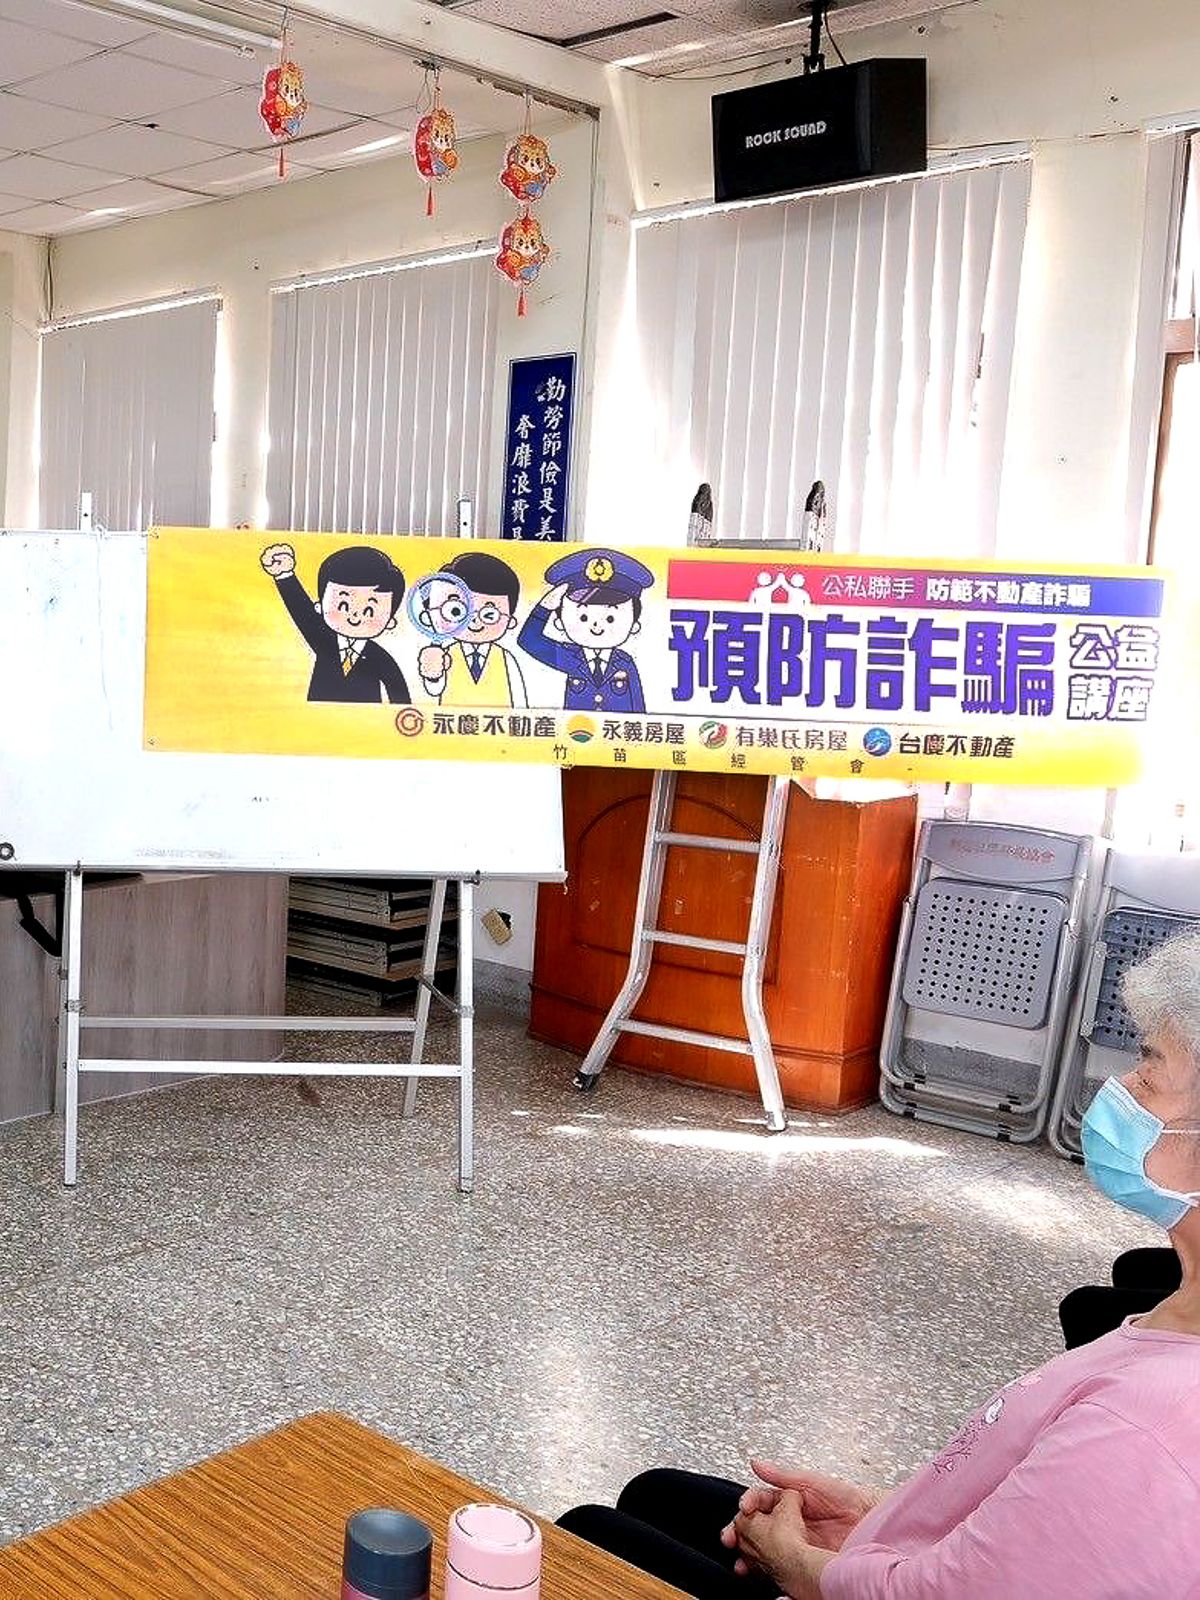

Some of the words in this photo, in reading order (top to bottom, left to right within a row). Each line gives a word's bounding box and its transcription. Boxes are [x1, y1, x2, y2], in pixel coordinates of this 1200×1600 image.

[745, 129, 781, 148] ROCK
[784, 120, 827, 140] SOUND
[822, 575, 914, 599] 公私聯手
[926, 578, 1091, 607] 防範不動產詐騙
[668, 609, 1056, 717] 預防詐騙
[1069, 623, 1159, 671] 公益
[1067, 675, 1153, 721] 講座
[433, 714, 556, 737] 永慶不動產
[602, 720, 685, 745] 永義房屋
[736, 727, 847, 751] 有巢氏房屋
[900, 732, 1015, 758] 台慶不動產
